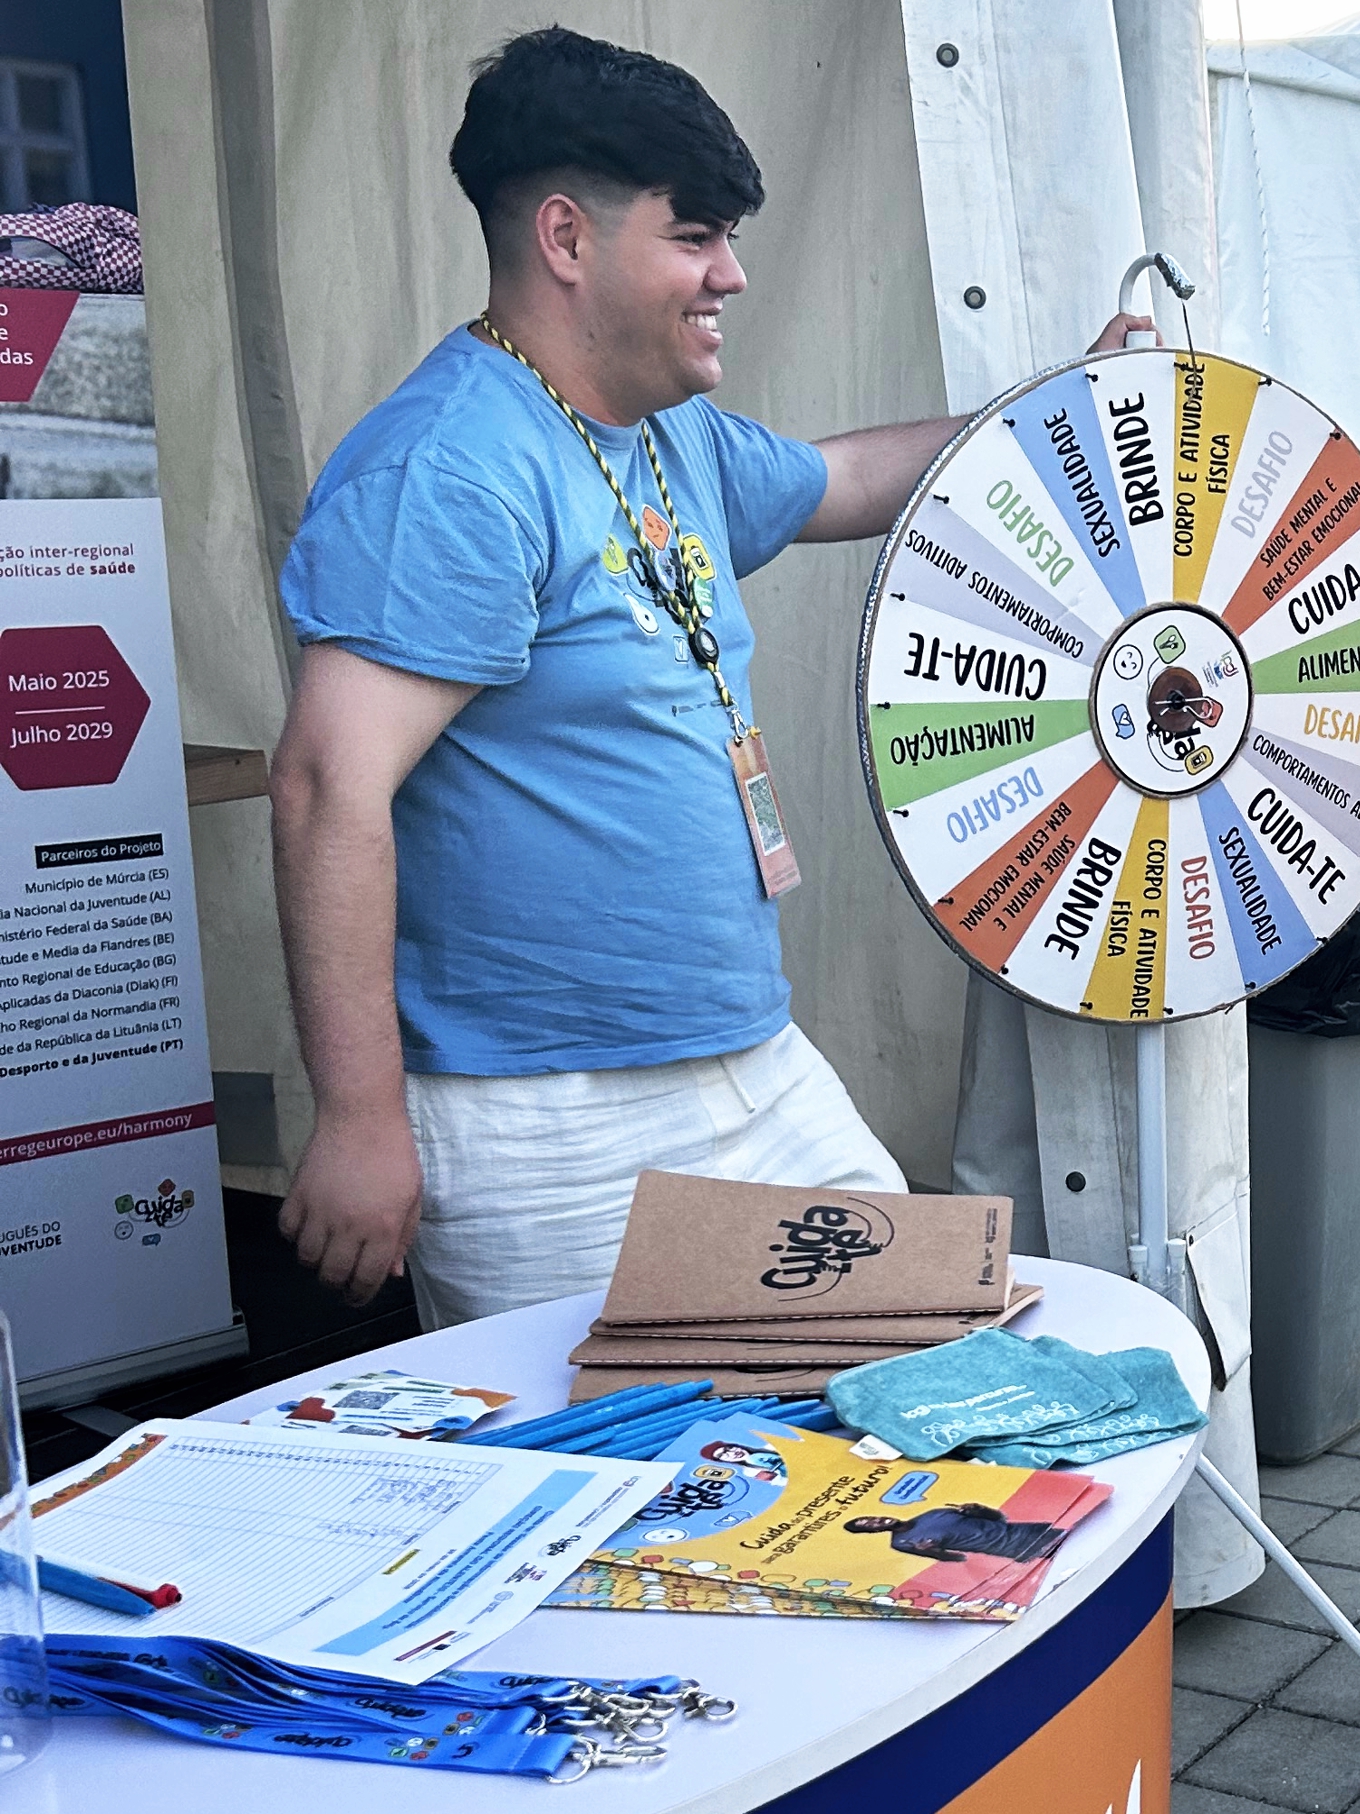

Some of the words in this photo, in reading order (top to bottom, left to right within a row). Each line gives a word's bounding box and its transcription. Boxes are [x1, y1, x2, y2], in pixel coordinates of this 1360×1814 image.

[1179, 362, 1205, 463] ATIVIDADE
[1043, 407, 1121, 558] SEXUALIDADE
[1109, 392, 1165, 527] BRINDE
[1178, 471, 1197, 483] E
[1207, 433, 1230, 494] FÍSICA
[1230, 430, 1294, 539] DESAFIO
[30, 543, 134, 561] inter-regional
[986, 479, 1076, 588] DESAFIO
[1173, 491, 1196, 557] CORPO
[1259, 529, 1293, 568] SAÚDE
[1288, 489, 1329, 535] MENTAL
[1325, 477, 1338, 493] E
[66, 563, 85, 576] de
[90, 560, 136, 575] saúde
[904, 528, 968, 580] ADITIVOS
[1262, 540, 1315, 601] BEM-ESTAR
[967, 570, 1085, 659] COMPORTAMENTOS
[8, 673, 57, 692] Maio
[62, 670, 110, 690] 2025
[903, 632, 1047, 701] CUIDA-TE
[10, 725, 61, 748] Julho
[66, 721, 113, 741] 2029
[890, 714, 1035, 767] ALIMENTAÇÃO
[1252, 734, 1351, 809] COMPORTAMENTOS
[946, 766, 1044, 843] DESAFIO
[41, 848, 98, 862] Parceiros
[100, 845, 117, 856] do
[120, 841, 161, 856] Projeto
[1015, 801, 1073, 869] BEM-ESTAR
[1040, 834, 1076, 876] SAÚDE
[1247, 787, 1346, 906] CUIDA-TE
[25, 876, 84, 894] Município
[87, 876, 103, 887] de
[106, 871, 146, 885] Múrcia
[148, 868, 169, 882] (ES)
[958, 863, 1020, 932] EMOCIONAL
[1002, 872, 1045, 920] MENTAL
[1044, 837, 1123, 961] BRINDE
[1143, 838, 1167, 901] CORPO
[1218, 826, 1283, 956] SEXUALIDADE
[14, 902, 67, 918] Nacional
[70, 900, 85, 912] da
[86, 893, 147, 912] Juventude
[150, 889, 171, 903] (AL)
[46, 920, 91, 936] Federal
[93, 919, 109, 931] da
[111, 915, 148, 929] Saúde
[150, 911, 173, 925] (BA)
[993, 917, 1007, 932] E
[1106, 900, 1131, 958] FÍSICA
[1140, 908, 1160, 919] E
[1180, 855, 1216, 960] DESAFIO
[22, 966, 73, 986] Regional
[76, 965, 91, 977] de
[95, 959, 150, 975] Educação
[153, 953, 177, 968] (BG)
[31, 951, 39, 961] e
[43, 944, 79, 959] Media
[82, 941, 98, 953] da
[100, 936, 151, 952] Flandres
[153, 932, 175, 946] (BE)
[1129, 926, 1158, 1019] ATIVIDADE
[19, 1012, 70, 1031] Regional
[73, 1010, 88, 1022] da
[91, 1001, 157, 1019] Normandia
[159, 996, 180, 1011] (FR)
[54, 991, 69, 1003] da
[72, 981, 123, 999] Diaconia
[126, 979, 159, 995] (Diak)
[161, 975, 178, 989] (FI)
[0, 1061, 59, 1078] Desporto
[62, 1058, 70, 1067] e
[73, 1054, 89, 1066] da
[91, 1045, 158, 1065] Juventude
[160, 1038, 184, 1053] (PT)
[16, 1041, 32, 1052] da
[34, 1031, 93, 1050] República
[95, 1029, 110, 1041] da
[113, 1021, 159, 1038] Lituânia
[161, 1017, 182, 1032] (LT)
[42, 1221, 61, 1233] DO
[760, 1204, 851, 1290] Cuida
[739, 1520, 793, 1550] Cuida
[795, 1475, 856, 1518] presente
